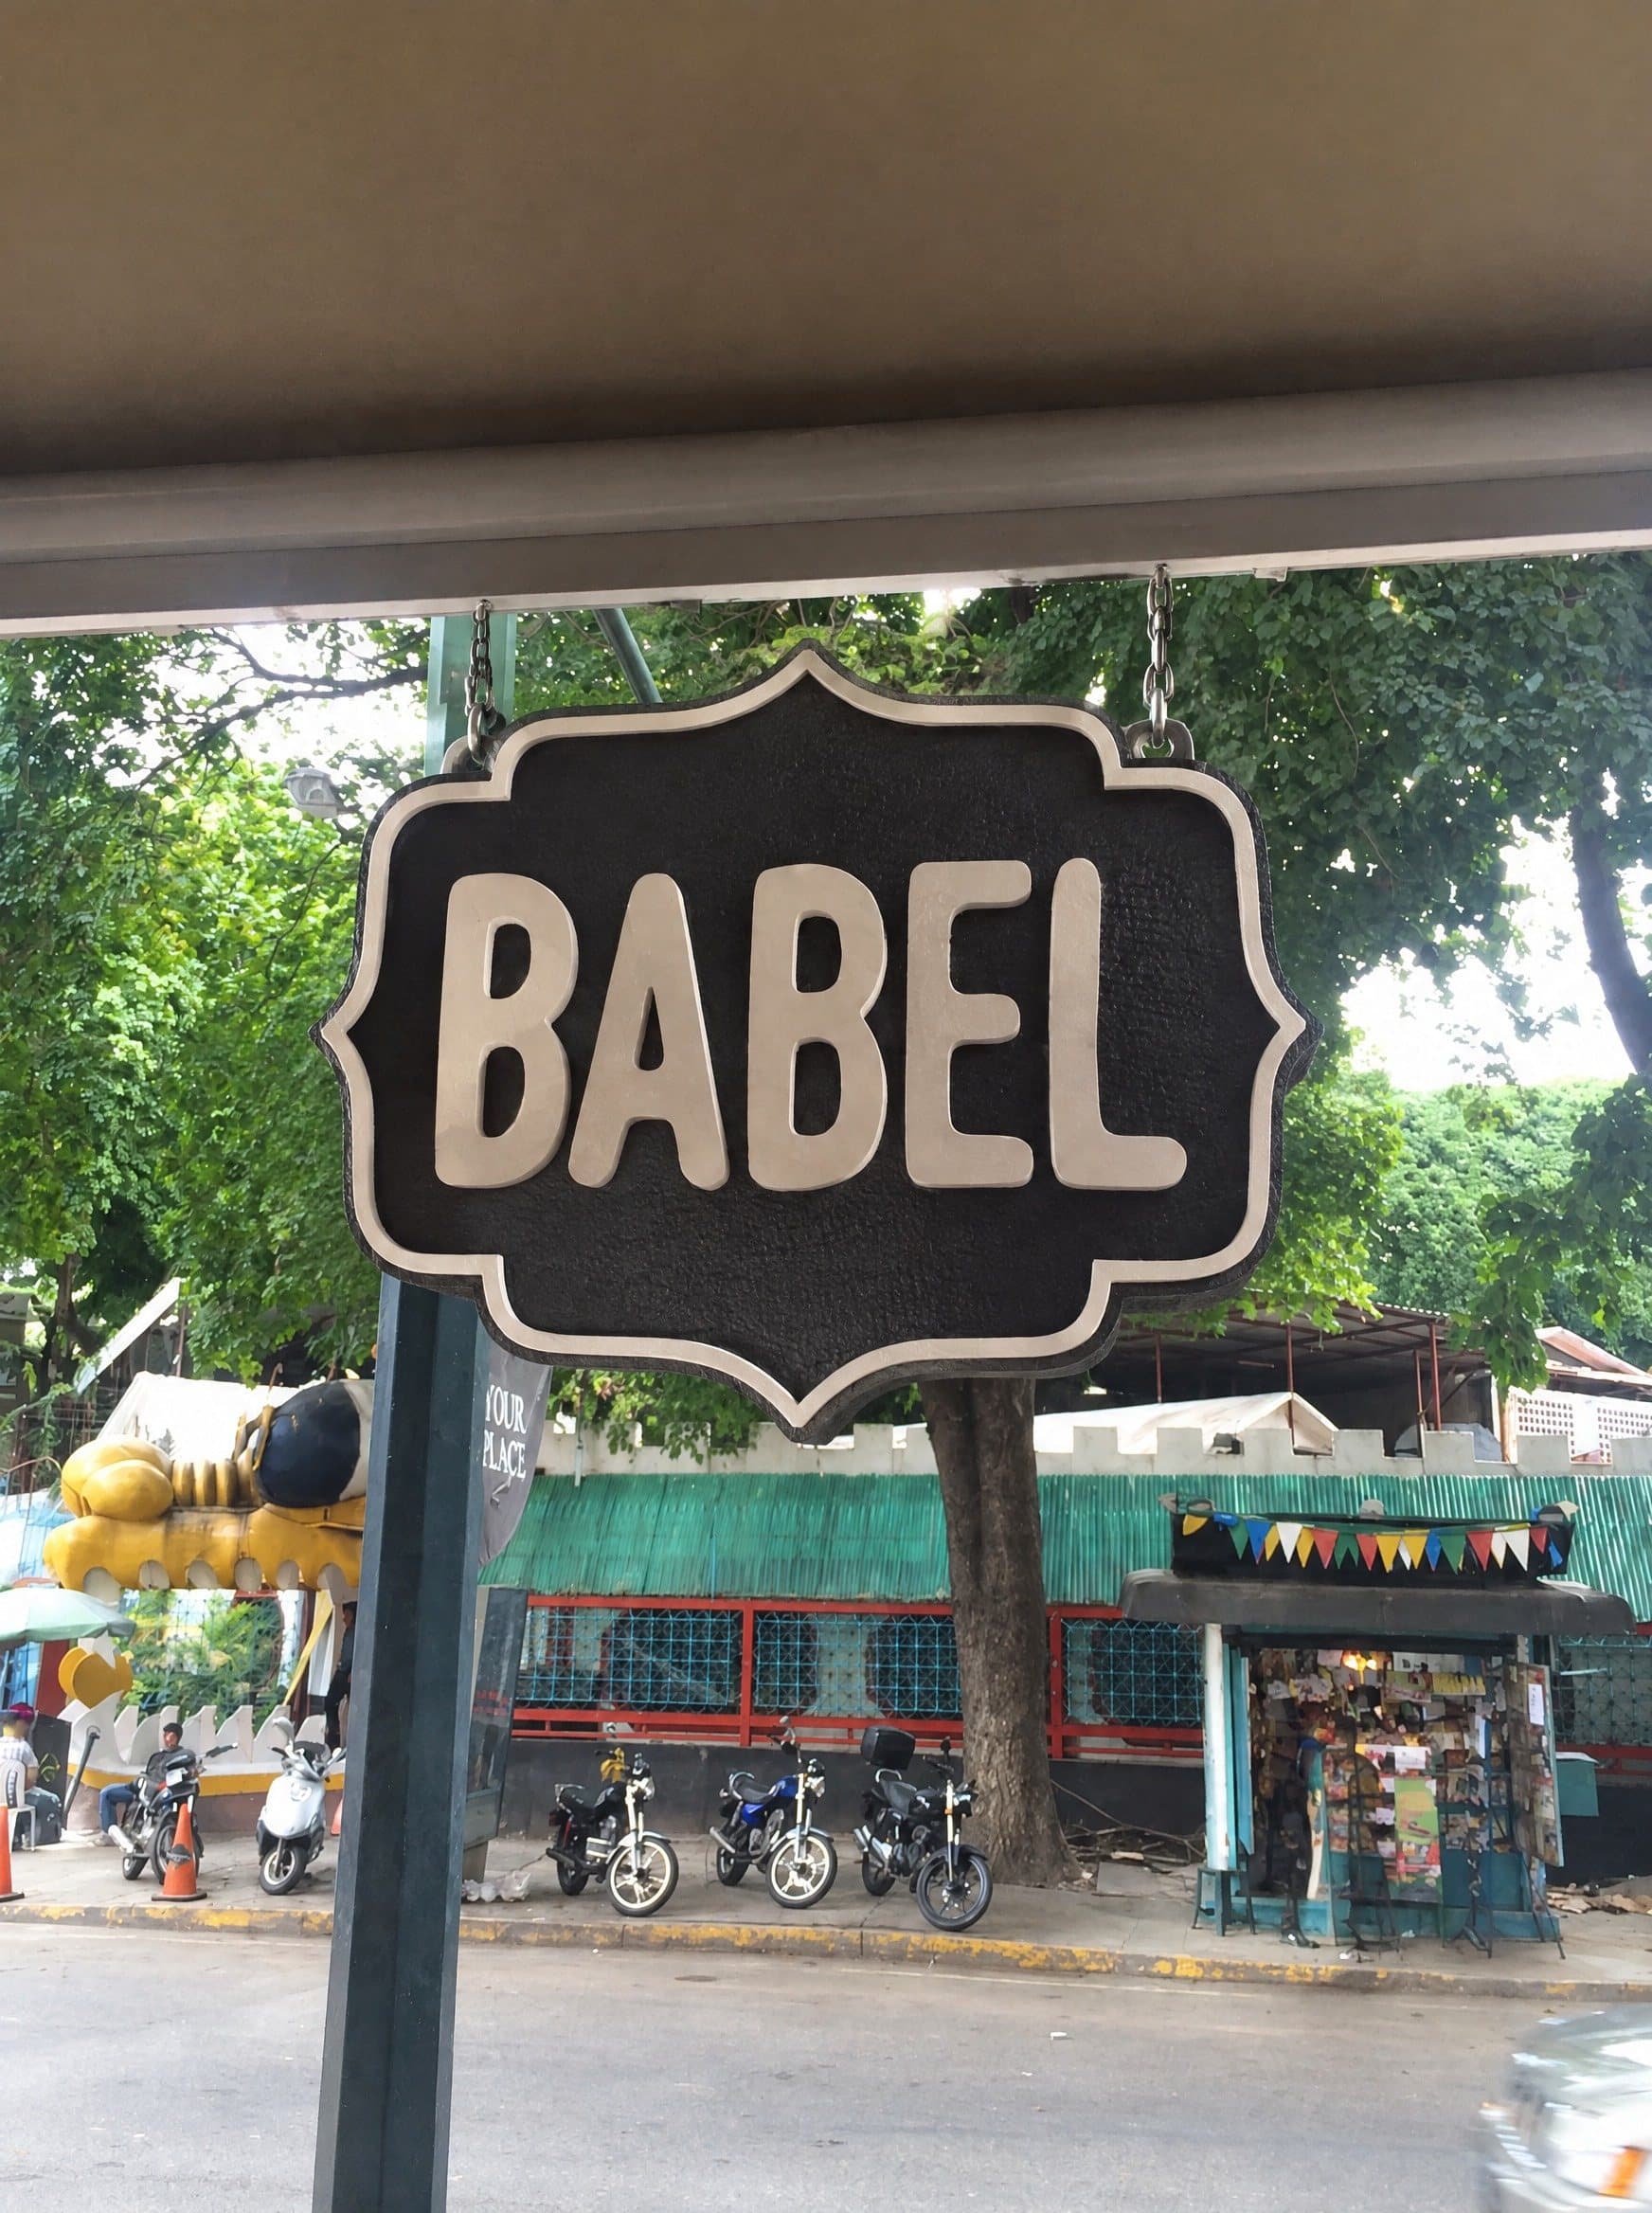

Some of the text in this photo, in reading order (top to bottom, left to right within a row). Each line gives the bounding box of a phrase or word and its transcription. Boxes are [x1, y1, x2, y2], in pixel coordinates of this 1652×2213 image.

[435, 858, 1187, 1192] BABEL
[485, 1384, 528, 1434] YOUR
[482, 1429, 527, 1479] PLACE
